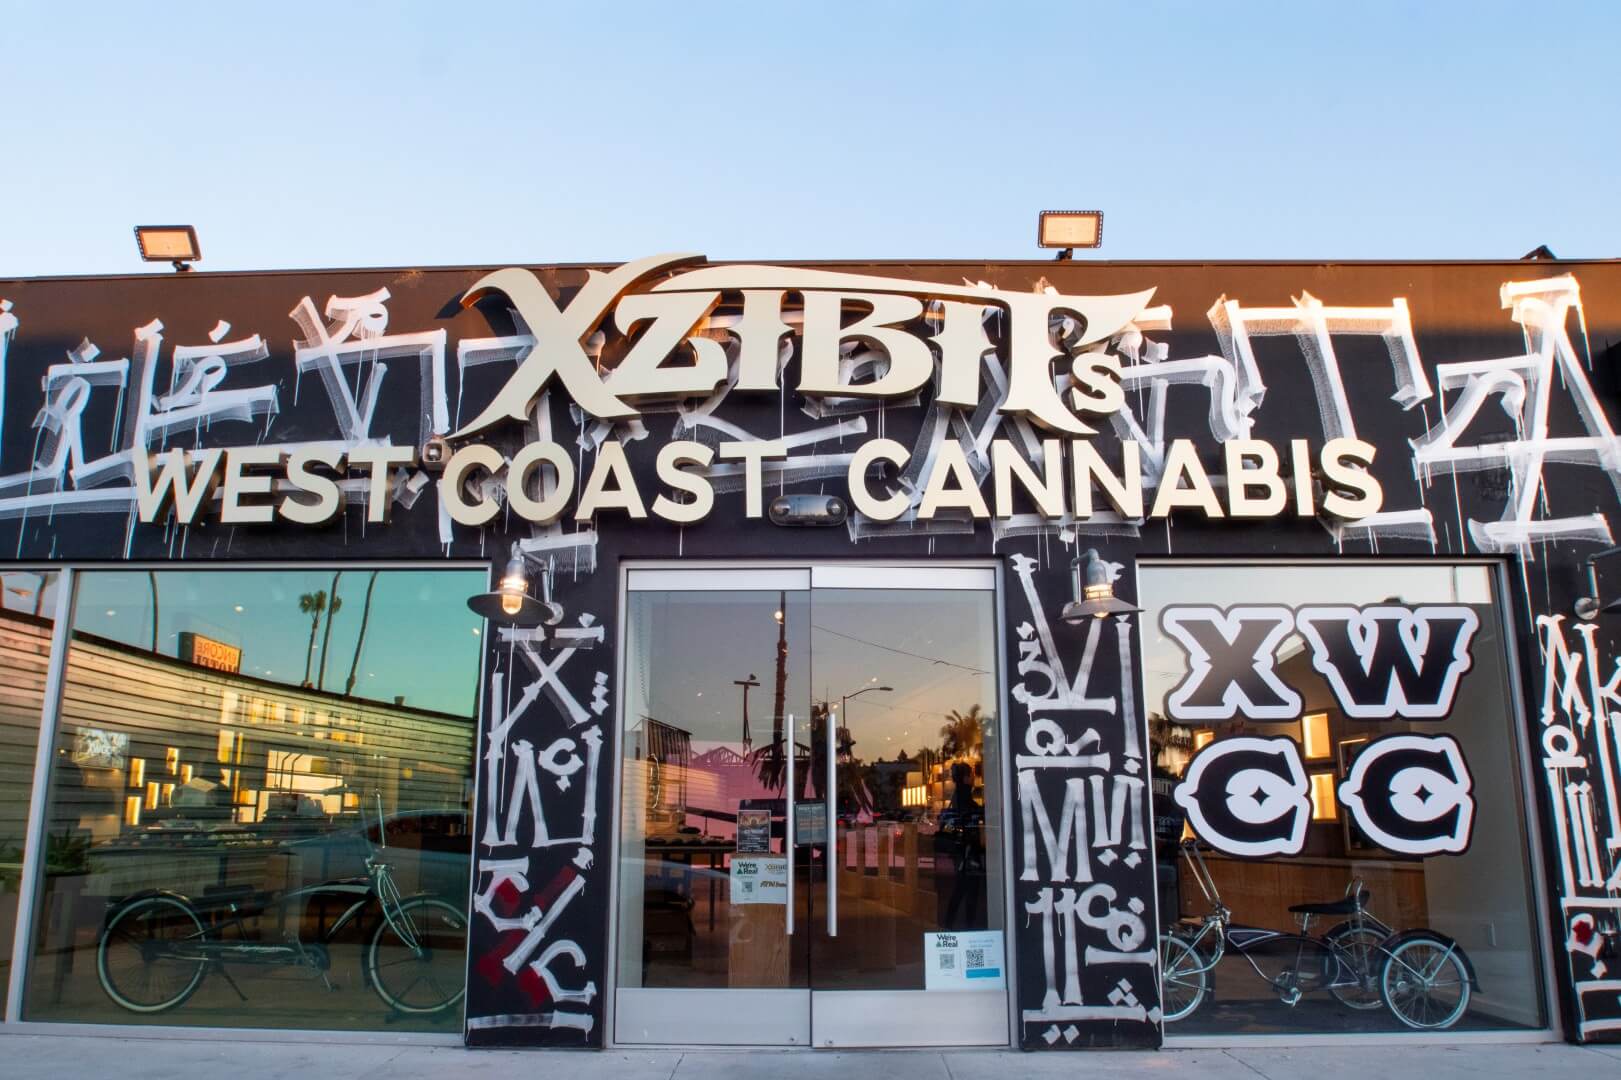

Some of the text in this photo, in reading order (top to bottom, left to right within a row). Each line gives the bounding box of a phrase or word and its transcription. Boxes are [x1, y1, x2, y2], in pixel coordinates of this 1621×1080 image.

[133, 438, 1383, 525] WEST COAST CANNABIS
